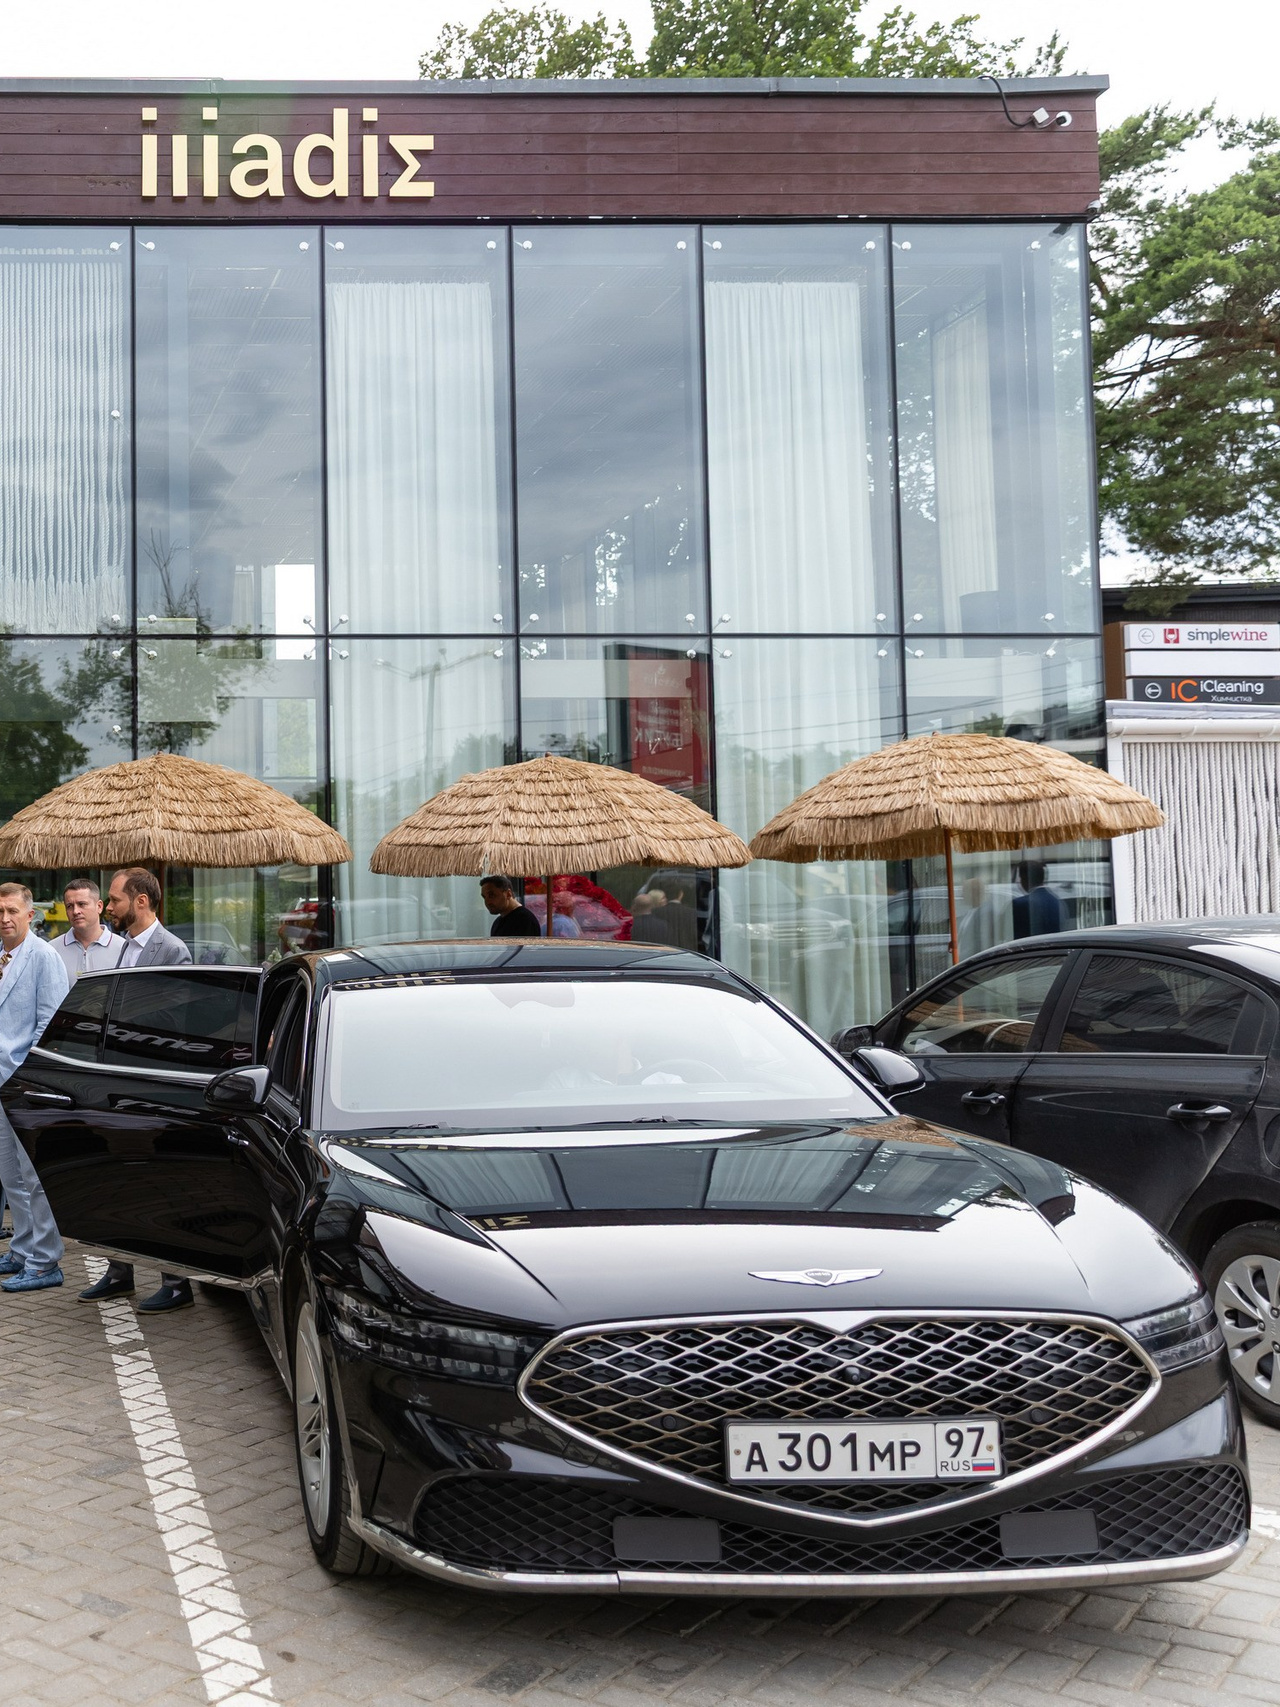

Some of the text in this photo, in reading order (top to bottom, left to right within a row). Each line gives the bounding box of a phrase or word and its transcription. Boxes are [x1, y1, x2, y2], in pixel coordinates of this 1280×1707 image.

[1187, 628, 1268, 644] simplewine
[1200, 680, 1264, 695] iCleaning
[944, 1426, 986, 1458] 97
[940, 1460, 971, 1472] RUS
